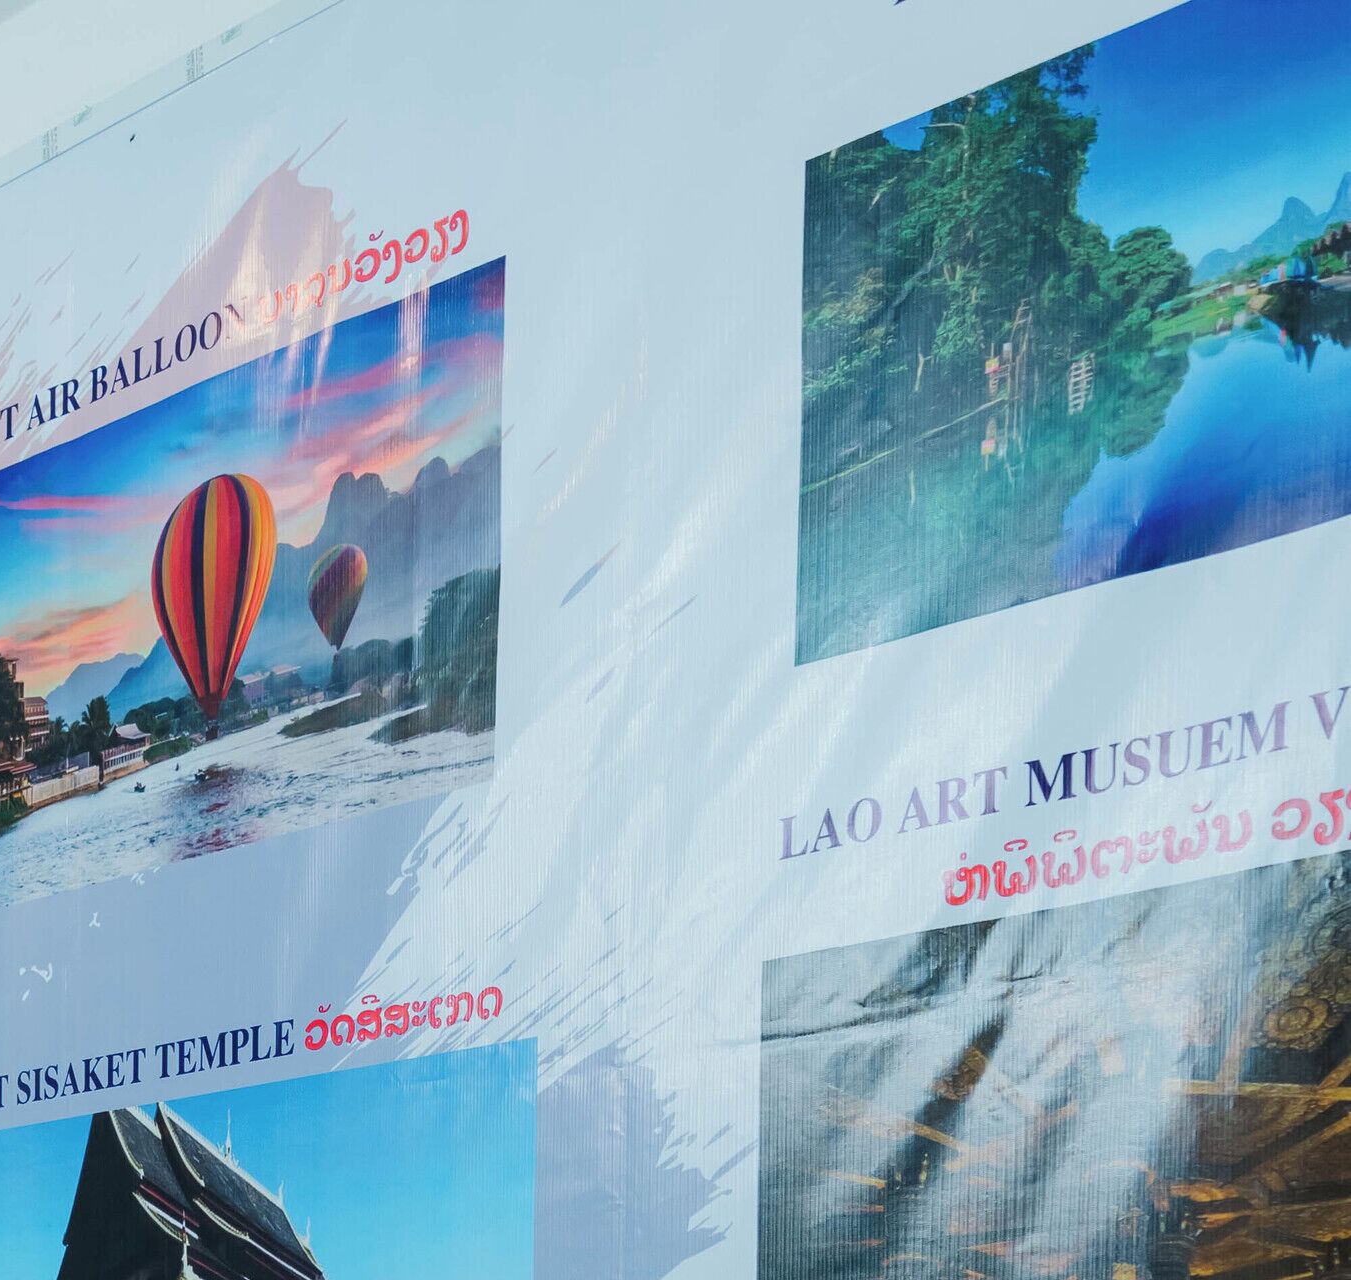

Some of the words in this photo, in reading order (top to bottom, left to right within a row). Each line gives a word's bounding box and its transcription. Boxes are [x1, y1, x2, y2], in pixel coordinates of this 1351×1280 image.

[26, 377, 82, 432] AIR
[90, 297, 248, 403] BALLOON
[778, 796, 884, 861] LAO
[897, 765, 1009, 835] ART
[1023, 700, 1292, 807] MUSUEM
[1309, 685, 1351, 740] V
[16, 1048, 146, 1106] SISAKET
[154, 1018, 296, 1080] TEMPLE
